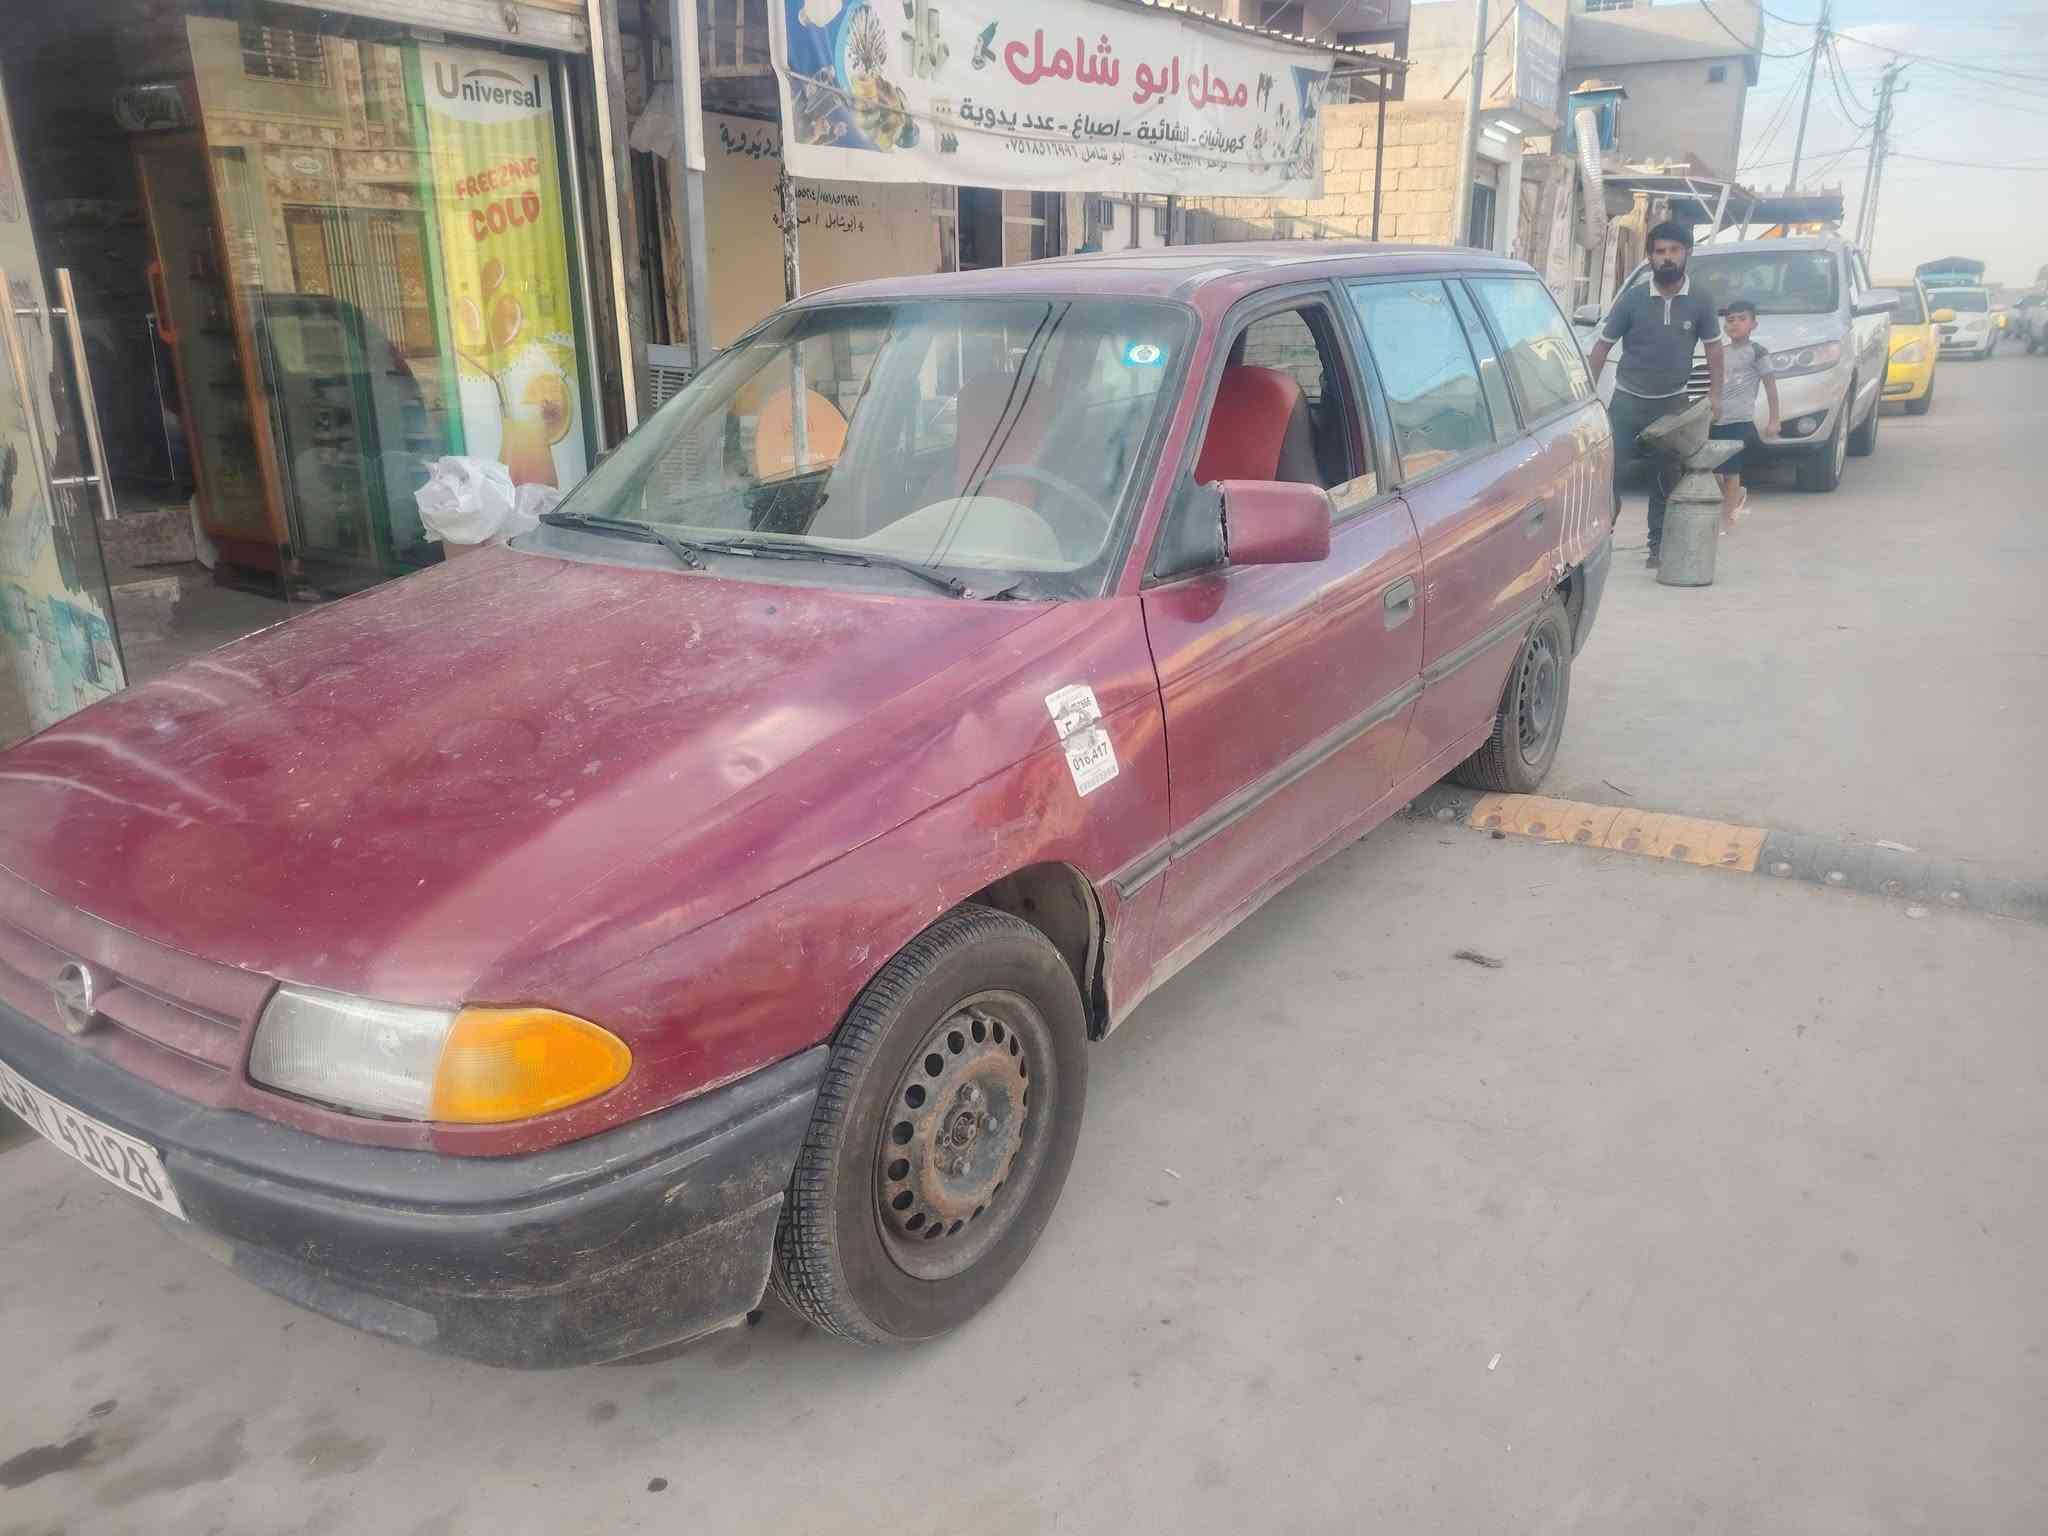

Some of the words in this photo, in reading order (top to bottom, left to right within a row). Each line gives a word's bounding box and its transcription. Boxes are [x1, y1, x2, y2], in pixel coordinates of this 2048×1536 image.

[1003, 29, 1120, 86] شامل
[1132, 55, 1180, 105] ابو
[434, 61, 542, 109] Universal
[1187, 63, 1248, 110] محل
[959, 97, 1017, 132] يدوية
[1021, 112, 1055, 131] عدد
[1071, 113, 1121, 140] اصباغ
[469, 190, 541, 241] COLD
